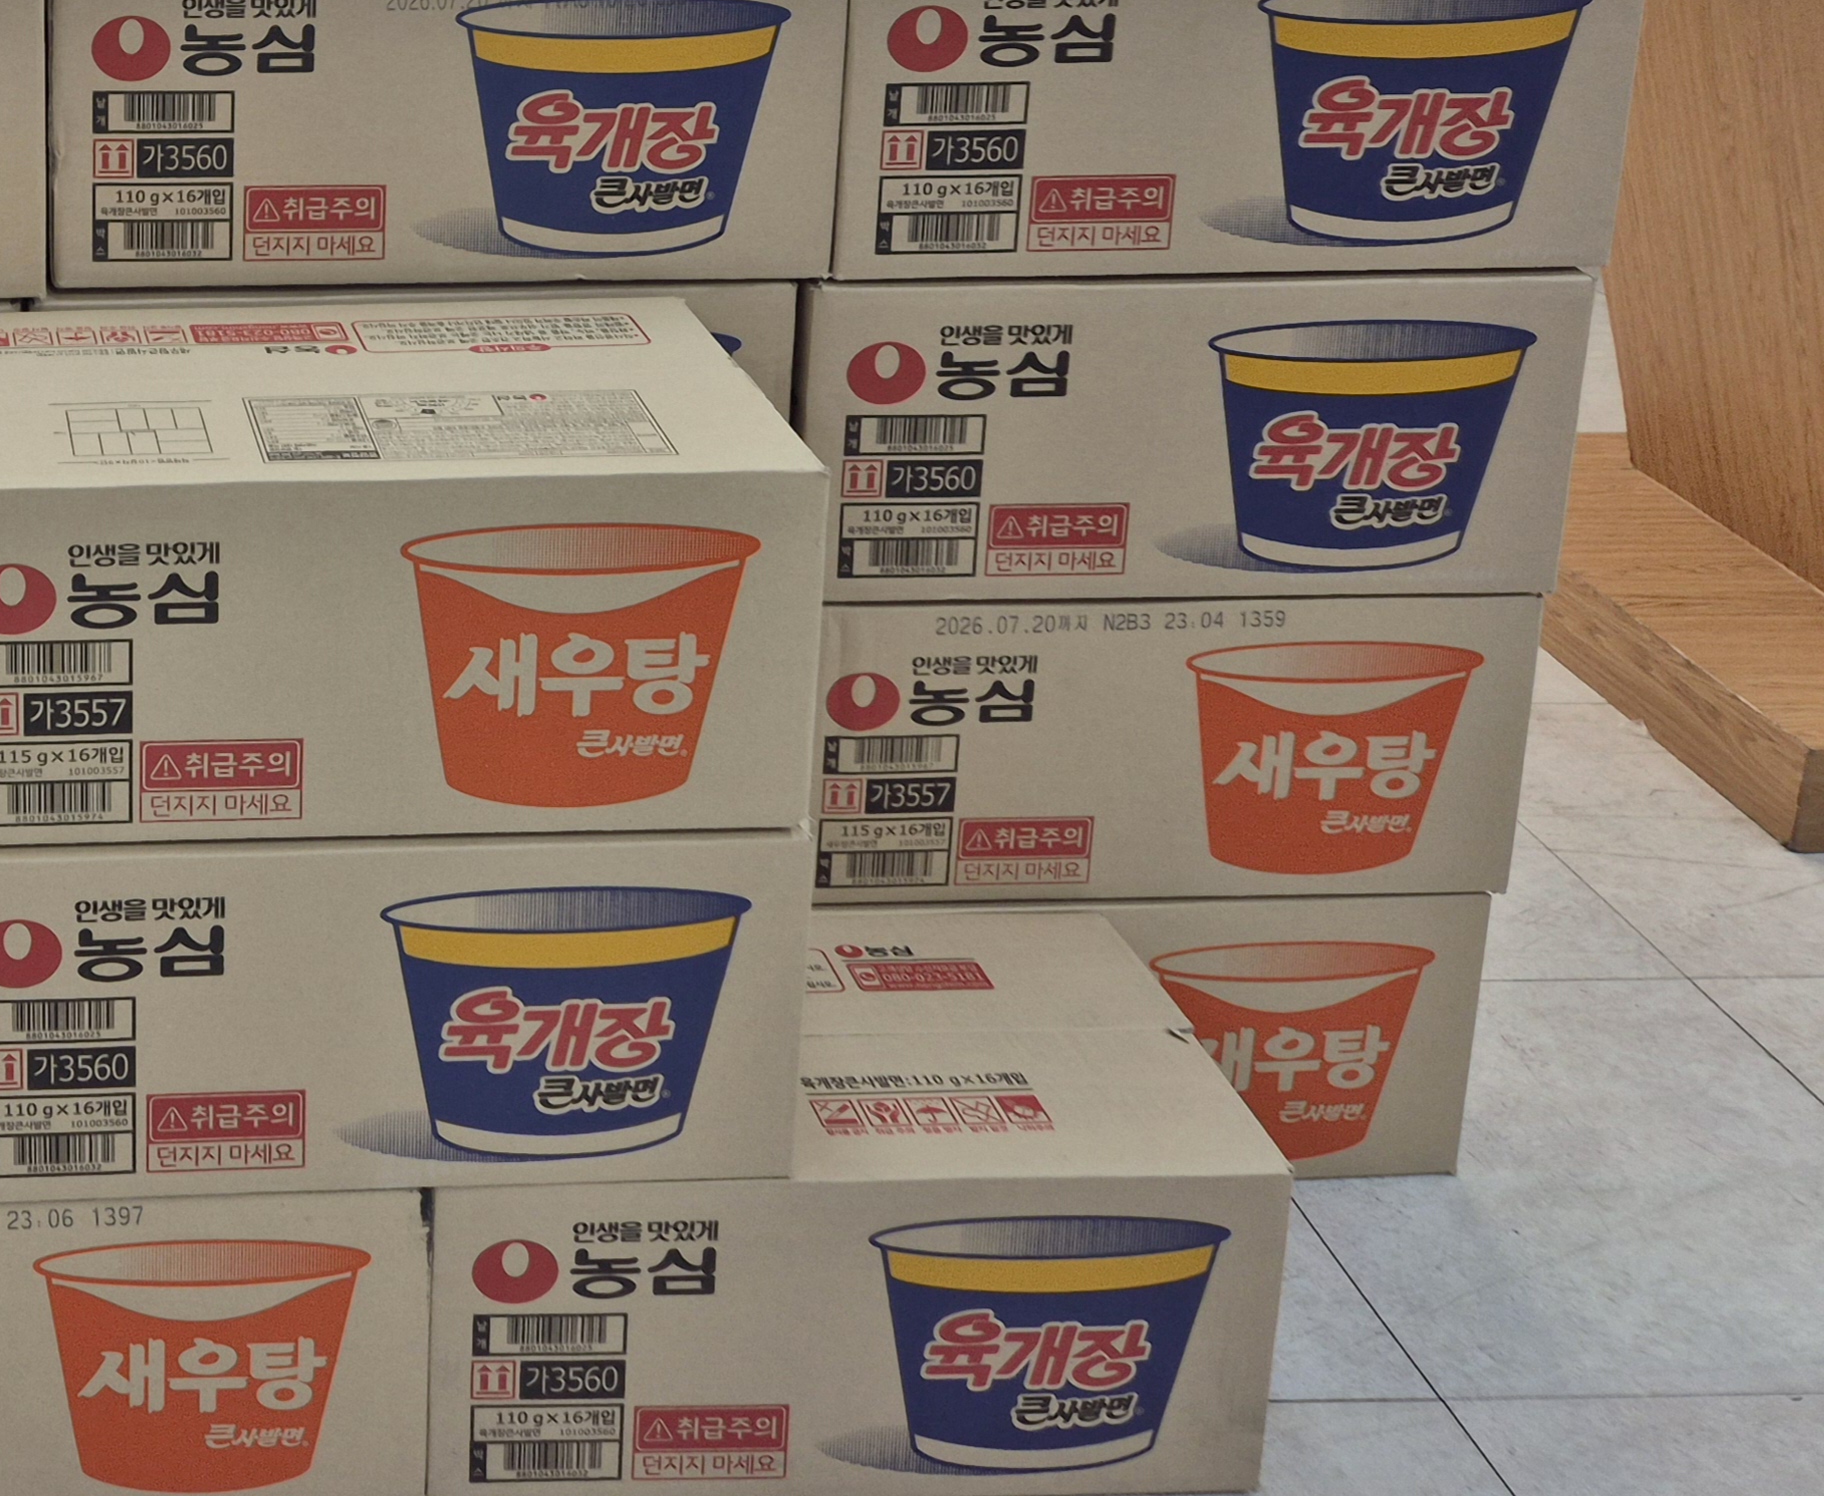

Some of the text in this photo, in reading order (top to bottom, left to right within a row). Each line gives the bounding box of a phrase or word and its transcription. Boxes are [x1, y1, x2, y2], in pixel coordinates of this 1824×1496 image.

[181, 21, 316, 79] 농심
[977, 11, 1116, 68] 농심
[507, 88, 718, 175] 육개장
[1298, 76, 1516, 161] 육개장
[143, 142, 228, 174] 가3560
[932, 134, 1020, 166] 가3560
[282, 196, 375, 223] 취급주의
[1069, 187, 1163, 213] 취급주의
[935, 348, 1070, 402] 농심
[1250, 410, 1461, 492] 육개장
[891, 464, 977, 494] 가3560
[1025, 514, 1118, 540] 취급주의
[68, 541, 220, 567] 인생을 맛있게
[68, 571, 219, 629] 농심
[1103, 612, 1151, 631] N2B3
[1239, 609, 1287, 629] 1359
[443, 632, 710, 717] 새우탕
[31, 698, 126, 730] 가3557
[907, 678, 1036, 727] 농심
[69, 767, 125, 775] 101003557
[185, 751, 291, 778] 취급주의
[1212, 730, 1437, 800] 새우탕
[870, 783, 951, 809] 가3557
[994, 826, 1084, 849] 취급주의
[75, 897, 225, 923] 인생을 맛있게
[75, 925, 225, 982] 농심
[865, 945, 915, 957] 농심
[882, 972, 984, 984] 080-023-5181
[440, 987, 674, 1072] 육개장
[34, 1053, 129, 1084] 가3560
[4, 1102, 38, 1117] 110
[71, 1118, 128, 1128] 101003560
[190, 1105, 293, 1130] 취급주의
[157, 1143, 295, 1166] 던지지 마세요
[92, 1206, 144, 1227] 1397
[570, 1245, 717, 1301] 농심
[921, 1308, 1151, 1392] 육개장
[76, 1336, 329, 1413] 새우탕
[526, 1364, 619, 1395] 가3560
[676, 1416, 777, 1442] 취급주의
